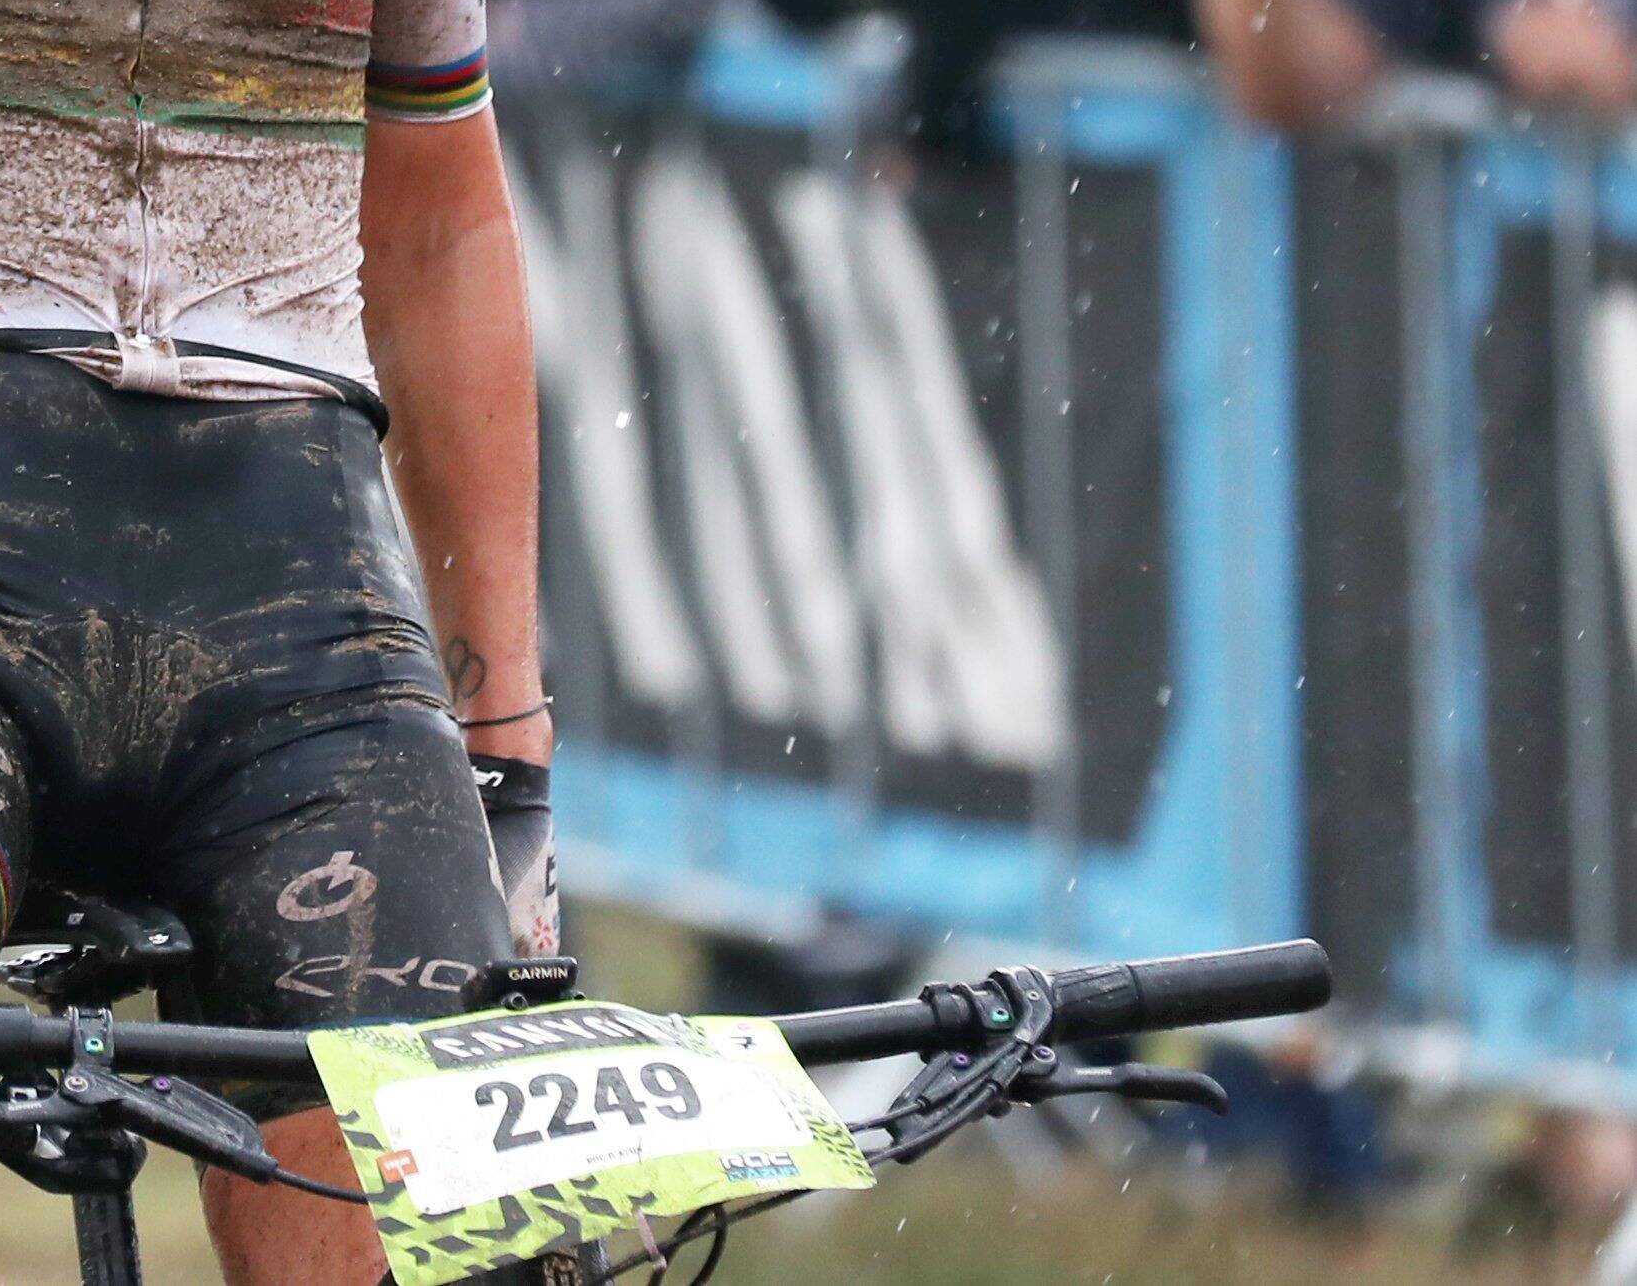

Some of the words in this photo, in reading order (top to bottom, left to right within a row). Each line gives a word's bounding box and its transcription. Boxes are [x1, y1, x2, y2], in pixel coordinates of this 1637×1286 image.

[508, 966, 569, 981] GARMIN
[474, 1061, 703, 1154] 2249
[719, 1152, 793, 1170] ROC
